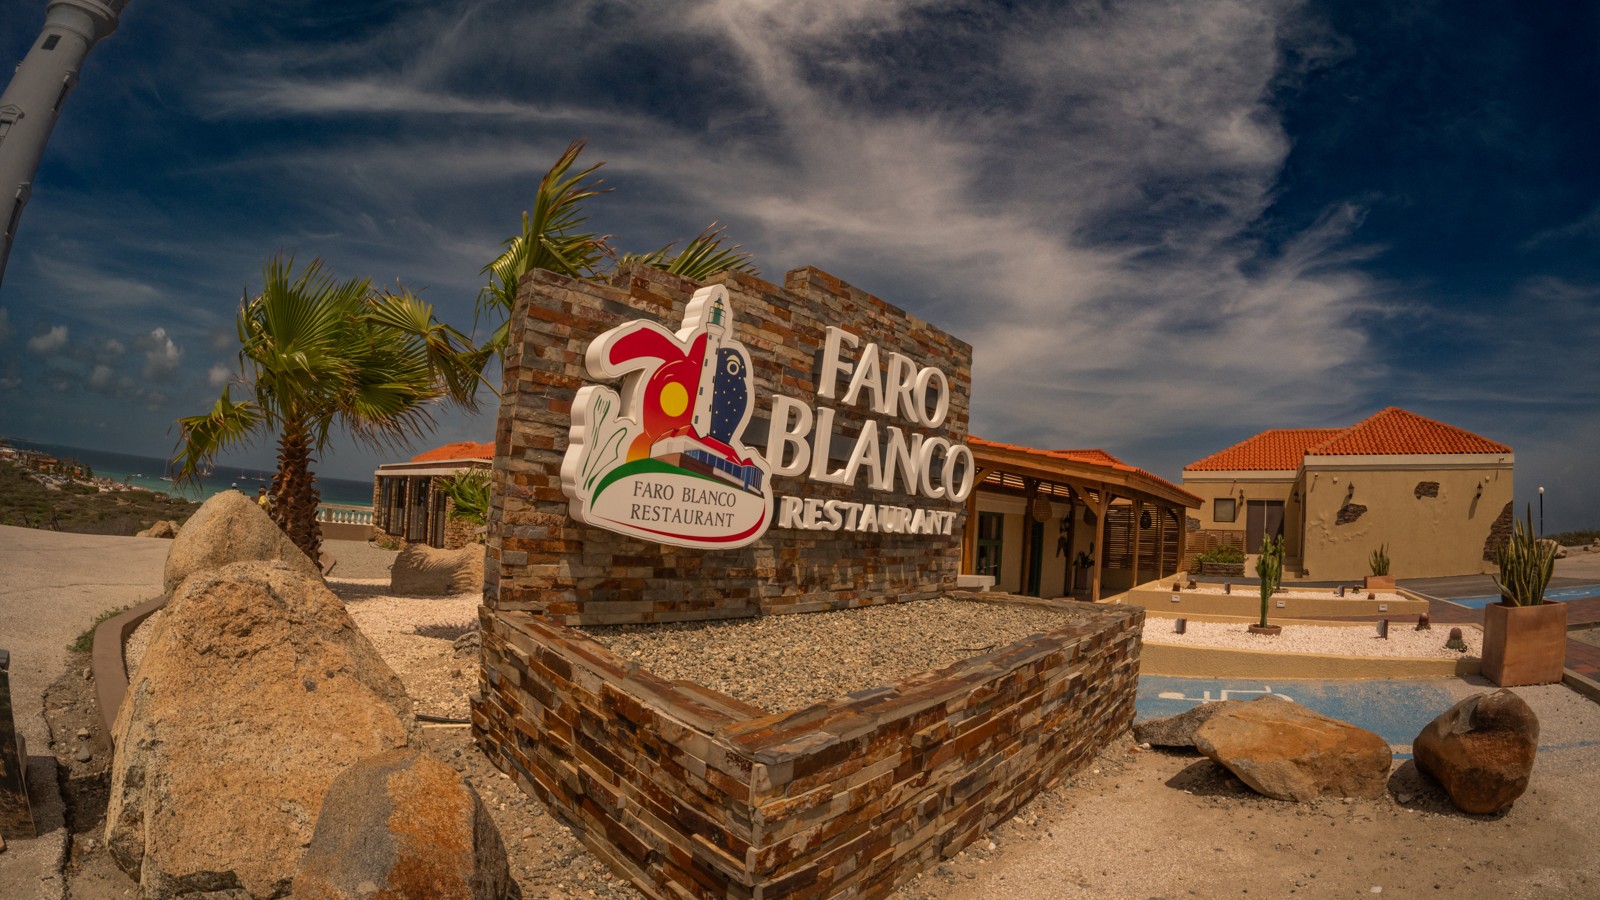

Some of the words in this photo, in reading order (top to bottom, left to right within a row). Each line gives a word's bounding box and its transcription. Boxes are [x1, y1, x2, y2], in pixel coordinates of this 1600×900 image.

[817, 325, 950, 429] FARO
[766, 394, 975, 503] BLANCO
[633, 481, 674, 501] FARO
[681, 487, 737, 508] BLANCO
[630, 503, 735, 528] RESTAURANT
[778, 495, 957, 536] RESTAURANT
